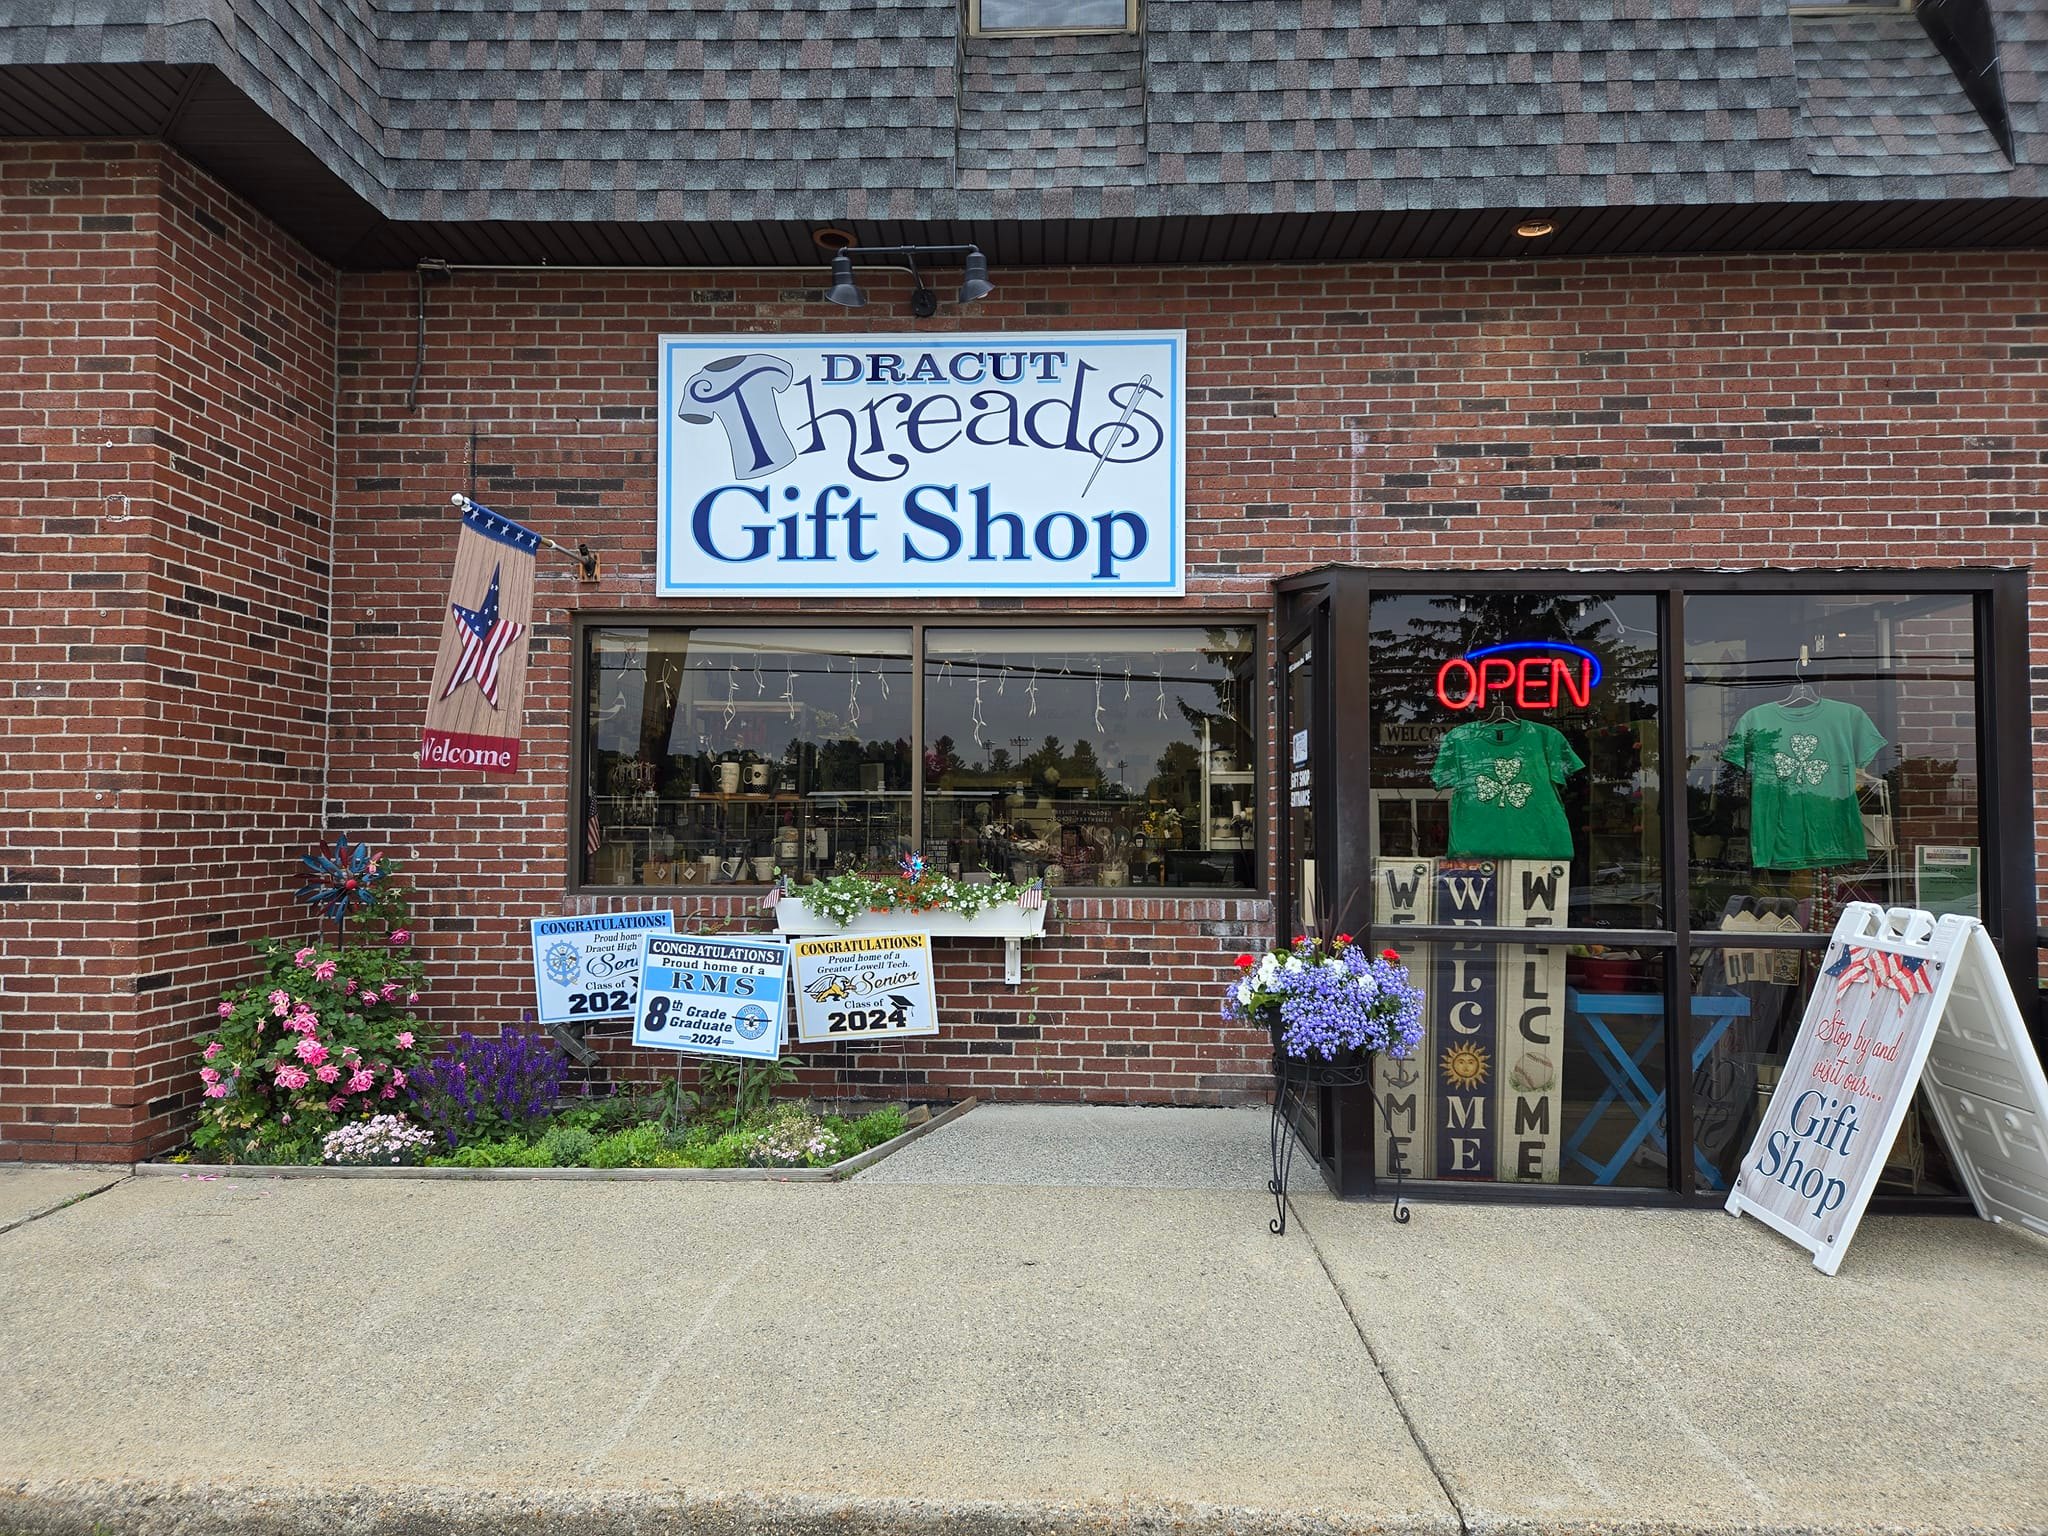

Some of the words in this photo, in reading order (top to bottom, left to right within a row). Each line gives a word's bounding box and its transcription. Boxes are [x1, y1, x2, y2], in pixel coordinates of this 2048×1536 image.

[820, 351, 1068, 385] DRACUT
[691, 359, 1165, 482] Threads
[690, 484, 879, 564] Gift
[902, 482, 1149, 581] Shop
[1436, 657, 1591, 710] OPEN
[1385, 724, 1448, 743] WELCO
[421, 737, 511, 768] Welcome
[540, 914, 667, 935] CONGRATULATIONS!
[585, 943, 615, 953] Dracut
[617, 940, 638, 951] High
[594, 934, 618, 943] Proud
[800, 935, 924, 956] CONGRATULATIONS!
[652, 941, 781, 963] CONGRATULATIONS!
[828, 953, 856, 964] Proud
[857, 953, 883, 962] home
[883, 951, 895, 960] of
[586, 952, 639, 978] Seni
[662, 957, 699, 969] Proud
[703, 961, 738, 973] home
[741, 965, 754, 974] of
[757, 967, 766, 975] a
[817, 965, 853, 974] Greater
[854, 962, 885, 972] Lowell
[886, 960, 911, 969] Tech.
[585, 981, 613, 991] Class
[615, 979, 626, 989] of
[671, 970, 757, 997] RMS
[853, 970, 919, 996] Senior
[686, 1006, 728, 1020] Grade
[844, 1000, 871, 1010] Class
[873, 998, 884, 1008] of
[669, 1016, 733, 1033] Graduate
[828, 1009, 907, 1033] 2024
[1815, 1010, 1852, 1055] Stop
[1853, 1019, 1870, 1065] by
[1871, 1032, 1903, 1063] and
[1811, 1056, 1849, 1086] visit
[1790, 1090, 1860, 1156] Gift
[1755, 1131, 1846, 1219] Shop
